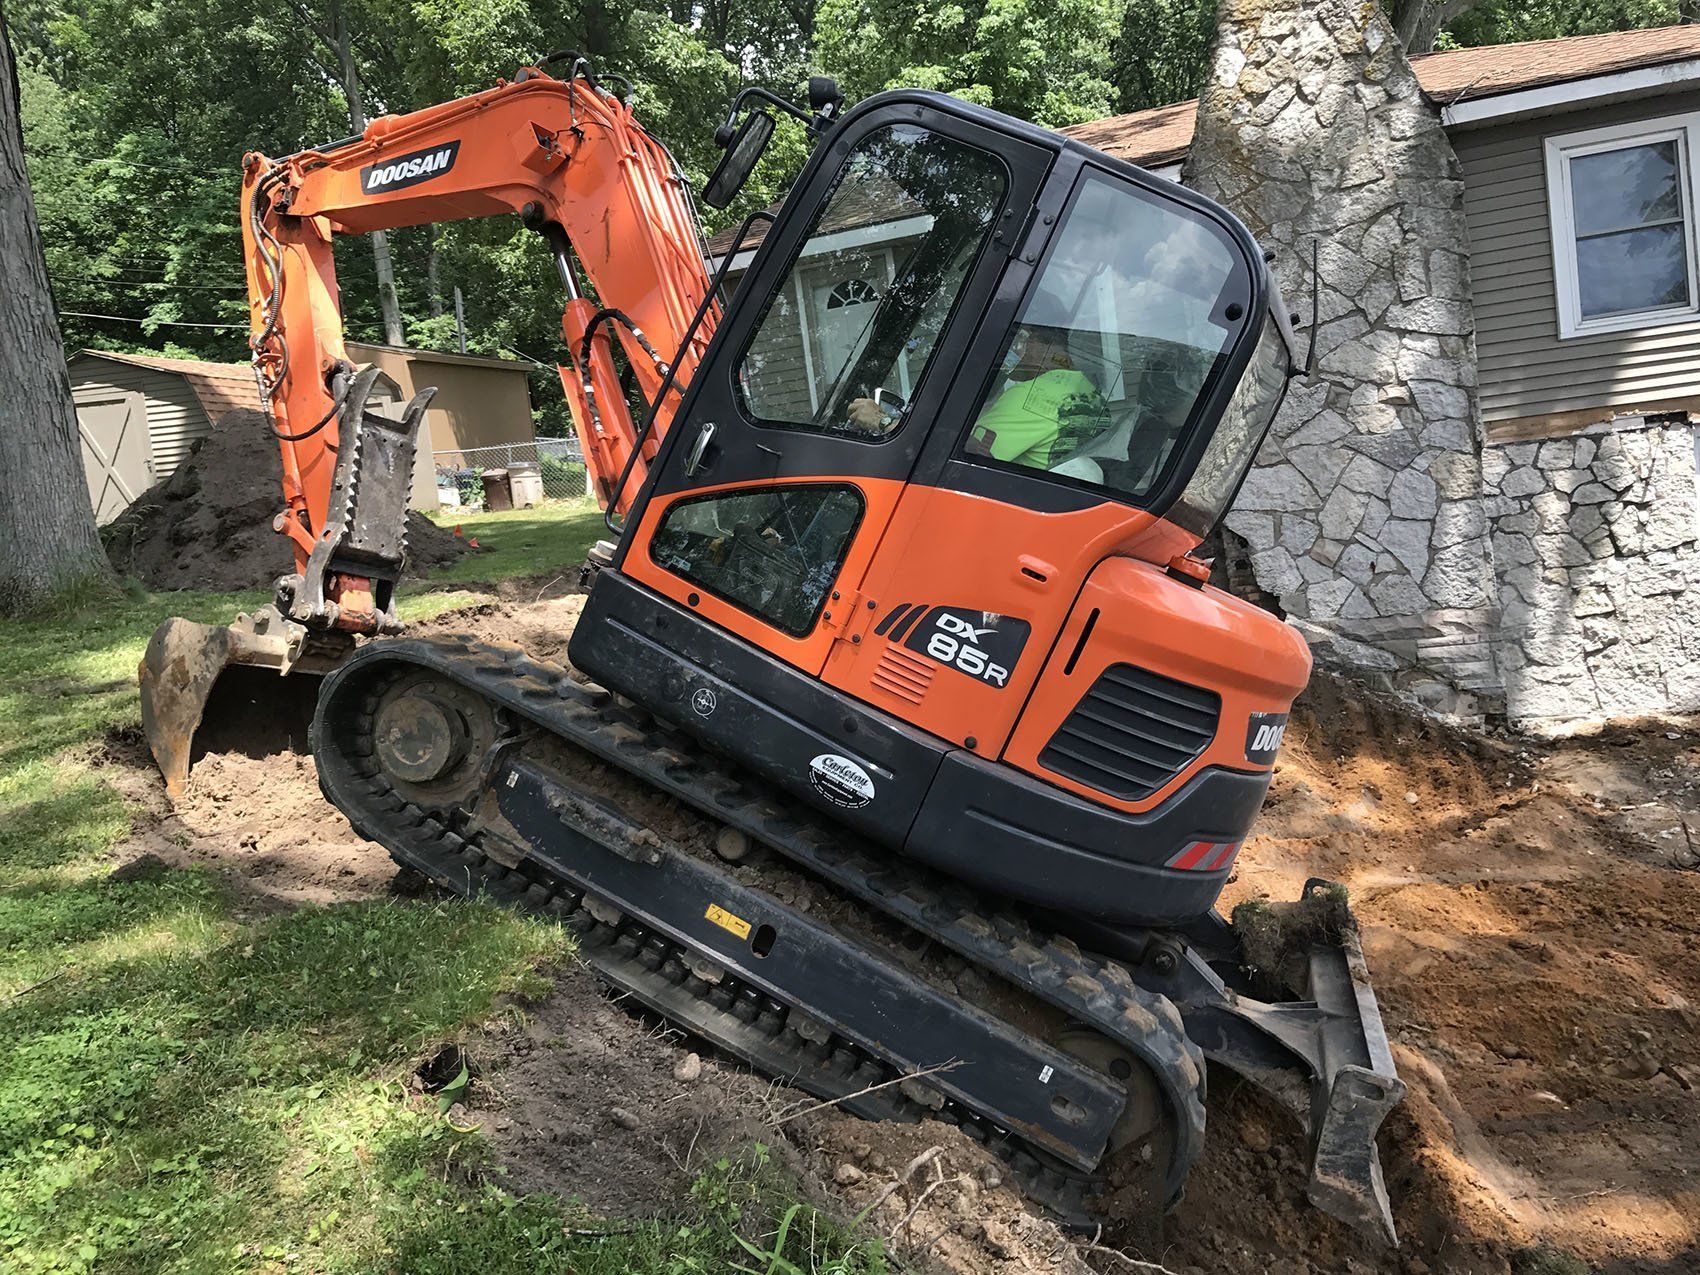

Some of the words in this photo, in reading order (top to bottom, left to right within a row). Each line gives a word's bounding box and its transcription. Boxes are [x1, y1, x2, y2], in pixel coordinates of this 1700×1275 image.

[367, 149, 451, 189] DOOSAN
[936, 613, 998, 644] DX
[927, 632, 1008, 687] 85R
[1251, 724, 1286, 751] DOO
[821, 757, 869, 787] Carleton
[822, 766, 852, 784] EQUIPMENT
